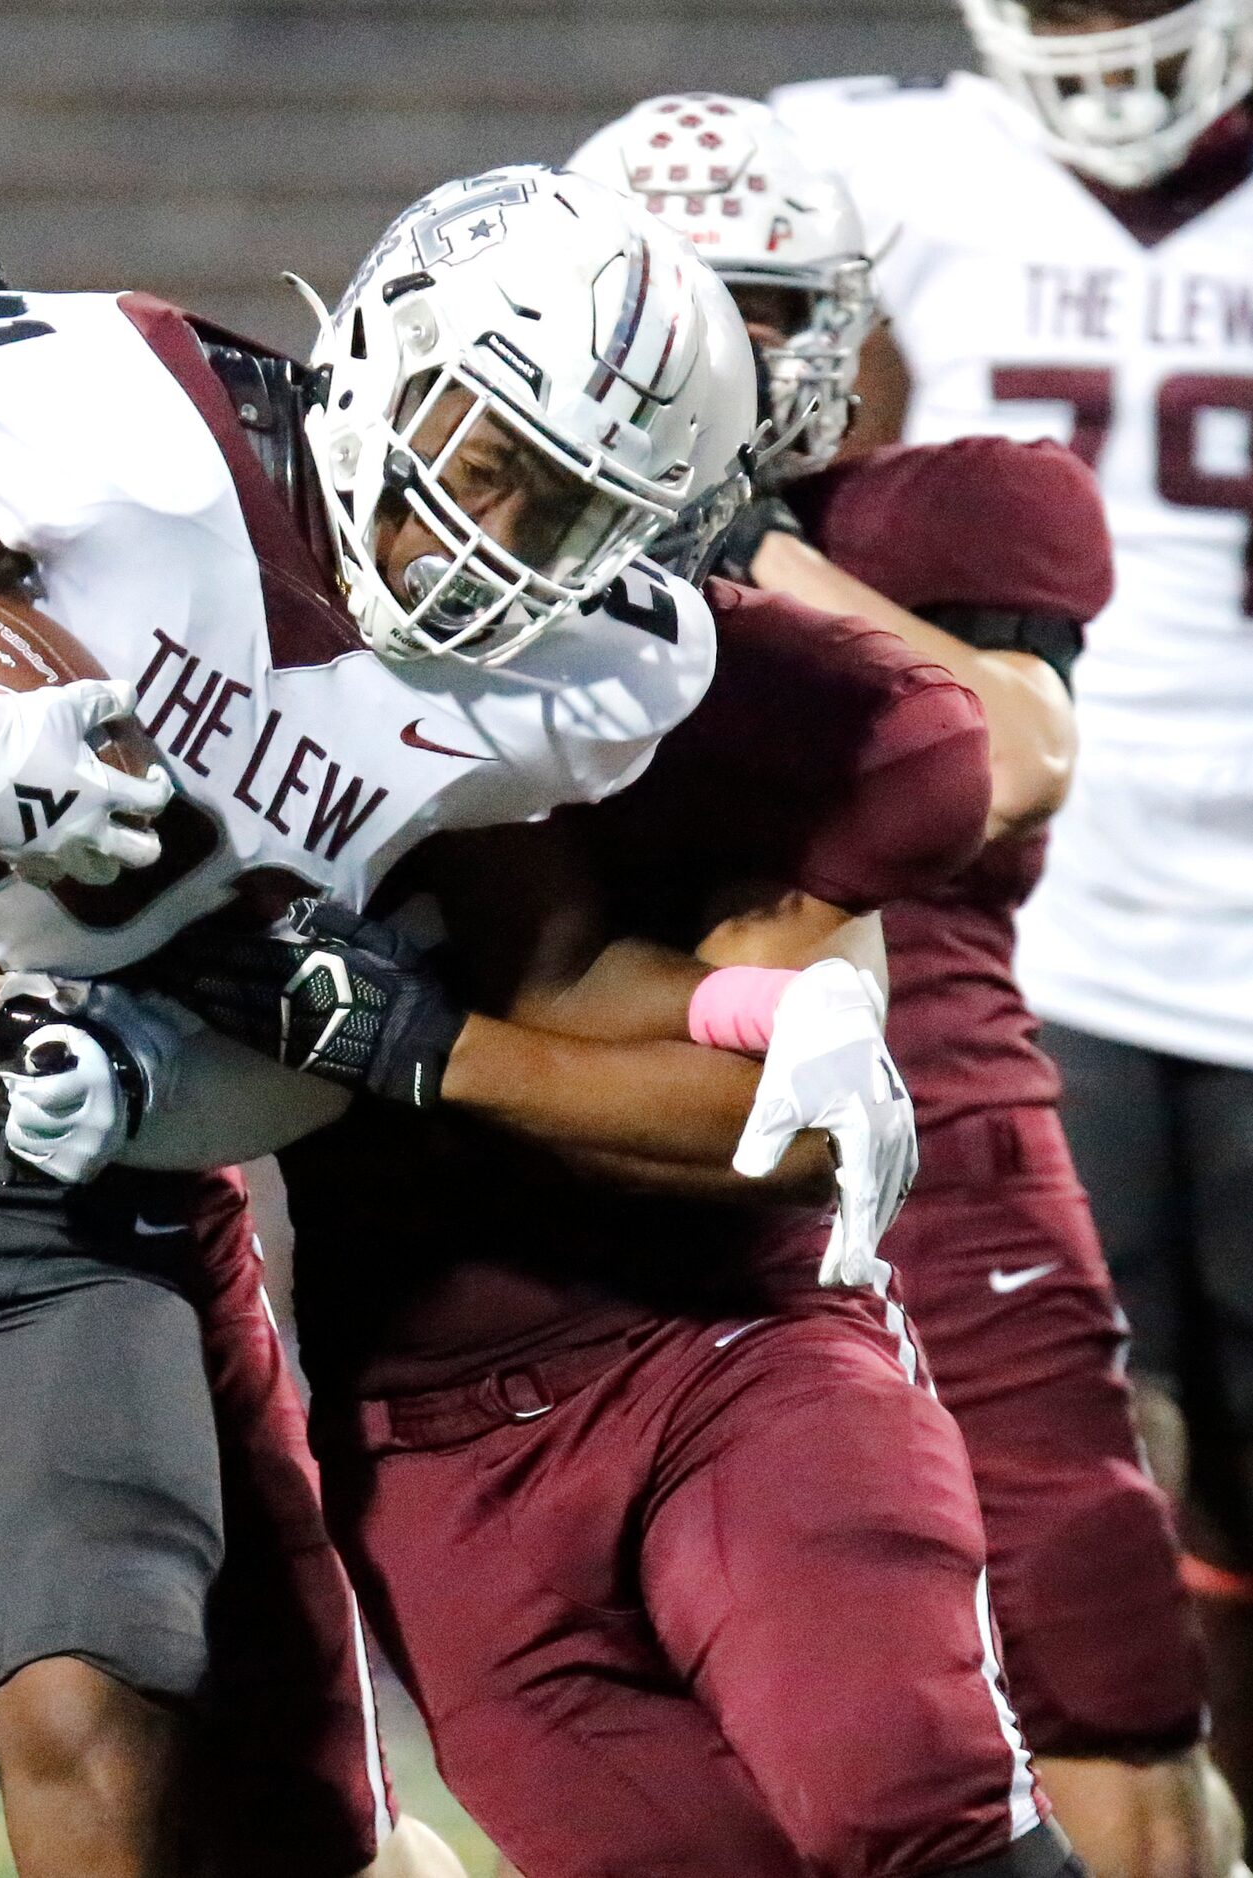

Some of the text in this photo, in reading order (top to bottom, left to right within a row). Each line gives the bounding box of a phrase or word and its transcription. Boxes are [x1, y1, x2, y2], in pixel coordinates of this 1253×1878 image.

[1023, 263, 1120, 340] THE
[0, 625, 60, 683] VAPOR
[135, 627, 390, 862] THE LEW
